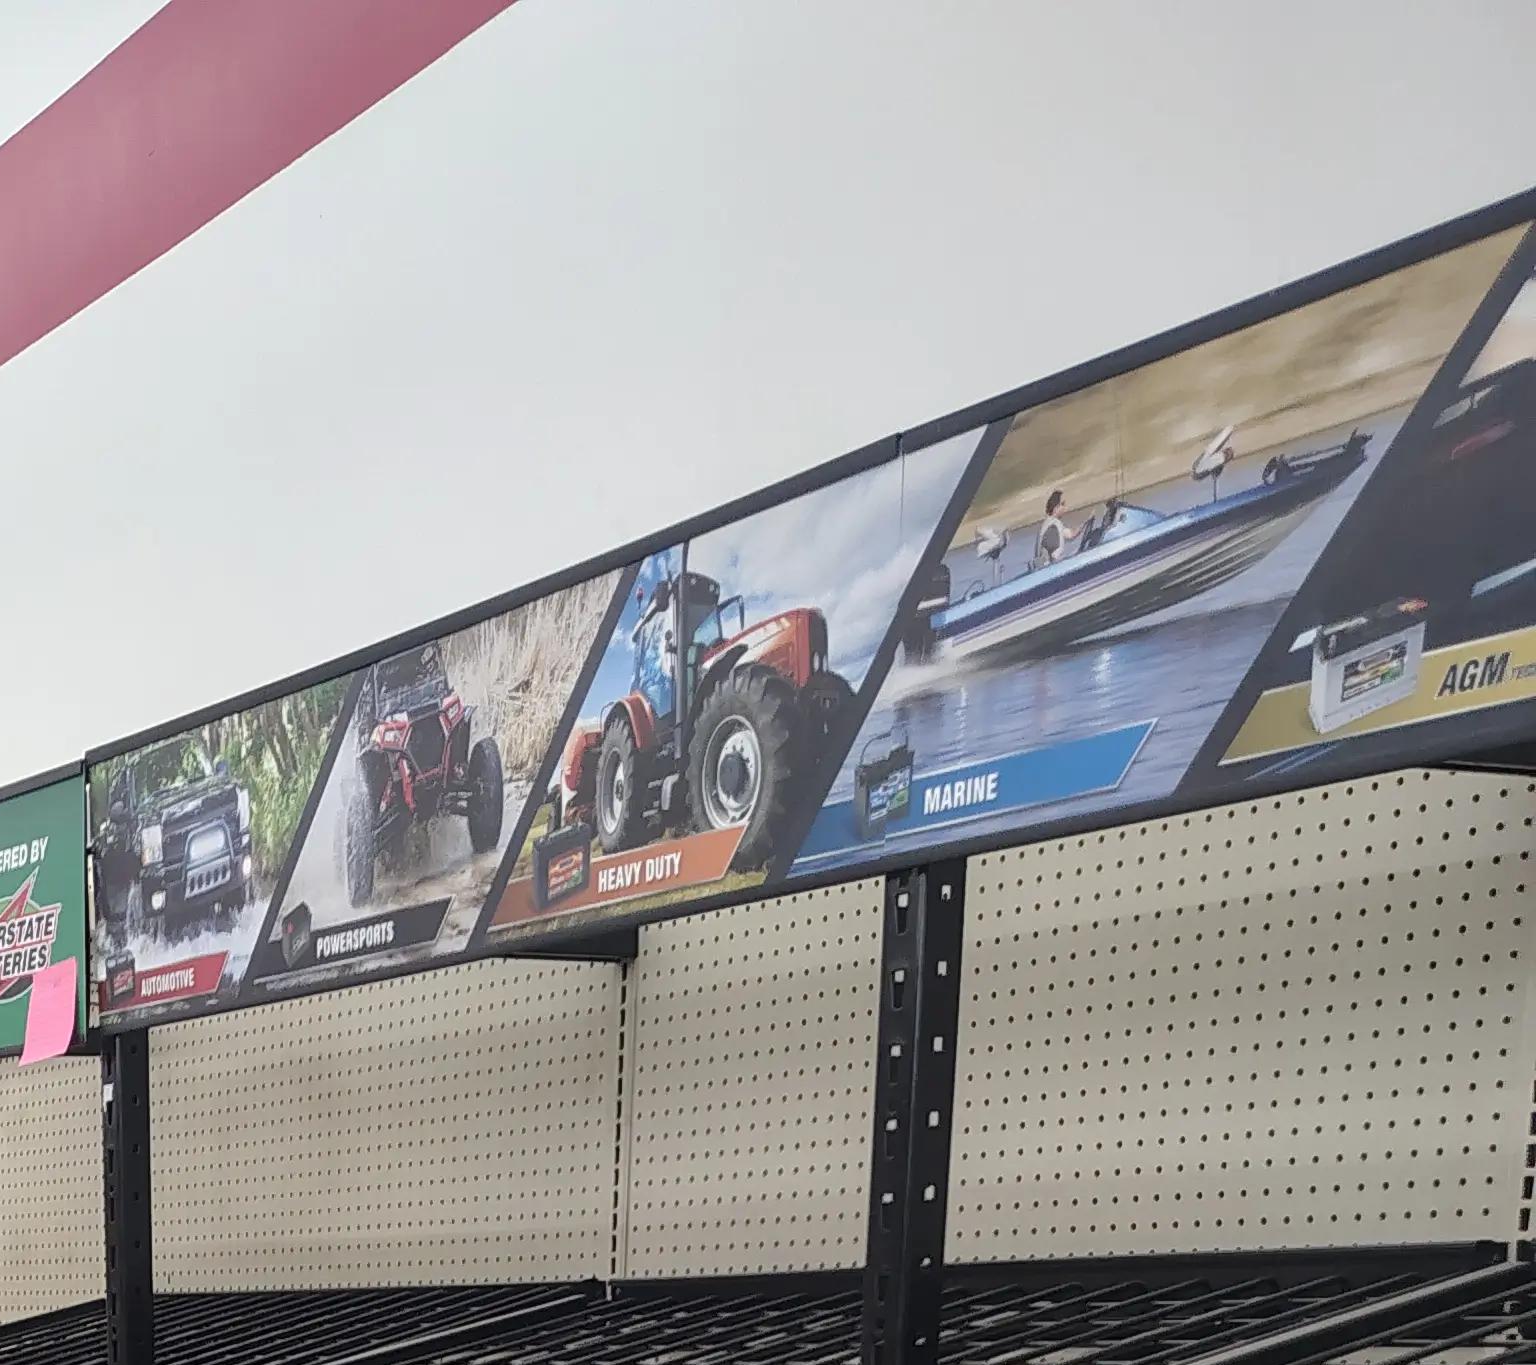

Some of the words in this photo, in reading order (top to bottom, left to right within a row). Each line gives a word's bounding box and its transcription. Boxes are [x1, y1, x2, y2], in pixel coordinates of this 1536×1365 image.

[1435, 651, 1511, 698] AGM
[923, 771, 1000, 816] MARINE
[29, 836, 49, 864] BY
[598, 860, 642, 894] HEAVY
[645, 850, 682, 880] DUTY
[316, 920, 395, 960] POWERSPORTS
[140, 966, 196, 998] AUTOMOTIVE
